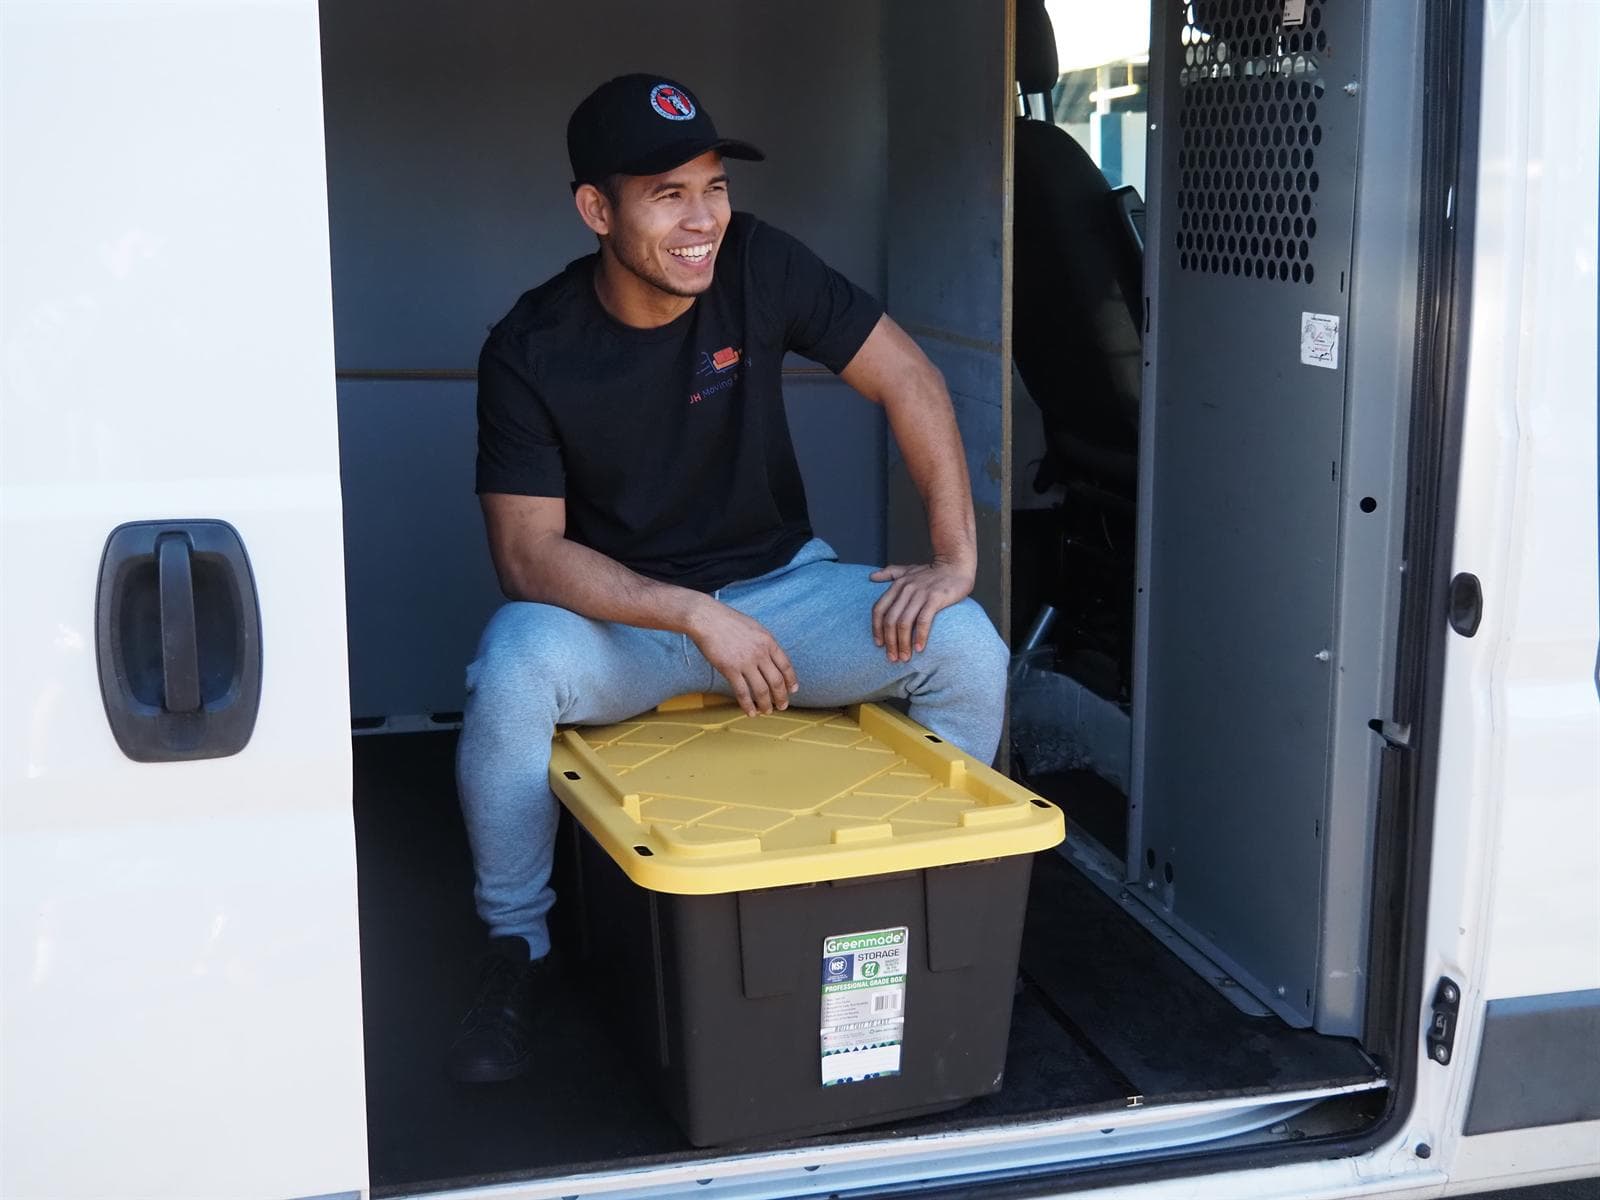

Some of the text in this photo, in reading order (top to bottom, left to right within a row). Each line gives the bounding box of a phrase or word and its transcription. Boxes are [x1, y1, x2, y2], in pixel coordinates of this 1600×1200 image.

[827, 933, 901, 951] Greenmade
[858, 949, 899, 961] STORAGE
[831, 960, 845, 971] NSF
[864, 962, 876, 974] 27
[825, 975, 904, 993] PROFESSIONAL GRADE BOX
